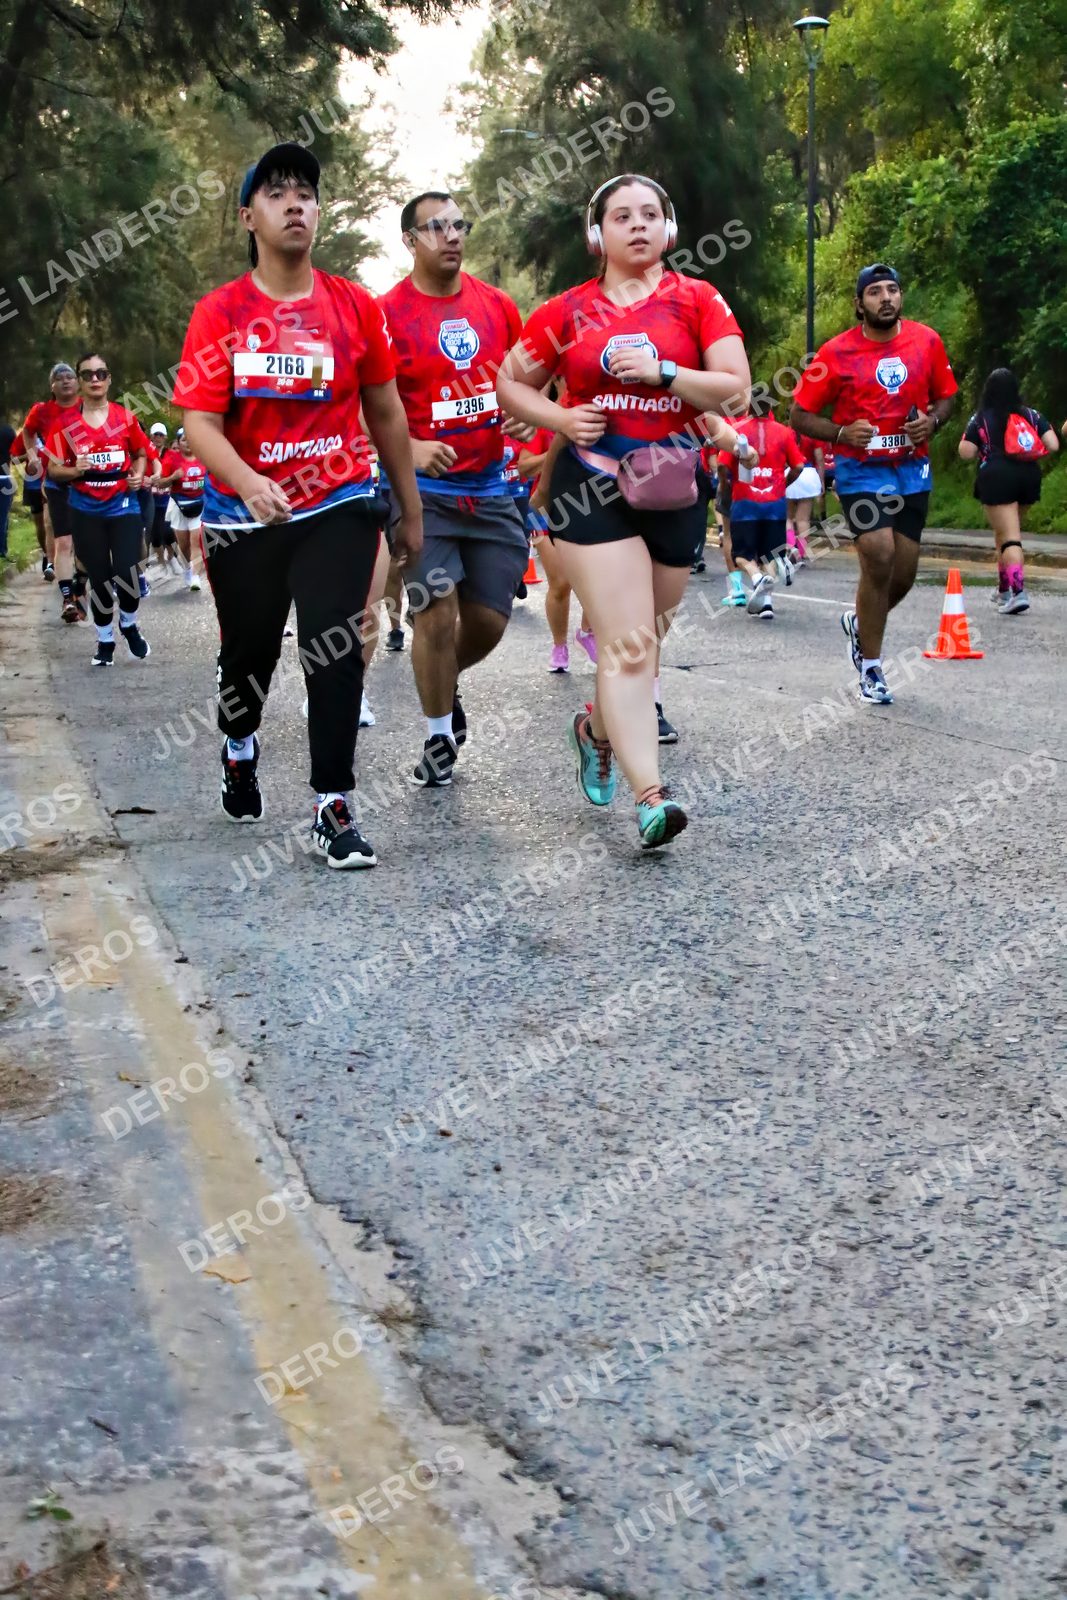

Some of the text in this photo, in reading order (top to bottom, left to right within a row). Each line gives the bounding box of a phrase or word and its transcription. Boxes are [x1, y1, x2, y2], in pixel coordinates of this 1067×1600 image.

[266, 355, 305, 376] 2168
[455, 396, 485, 416] 2396
[592, 393, 682, 413] SANTIAGO
[258, 434, 343, 463] SANTIAGO
[881, 434, 906, 448] 3380
